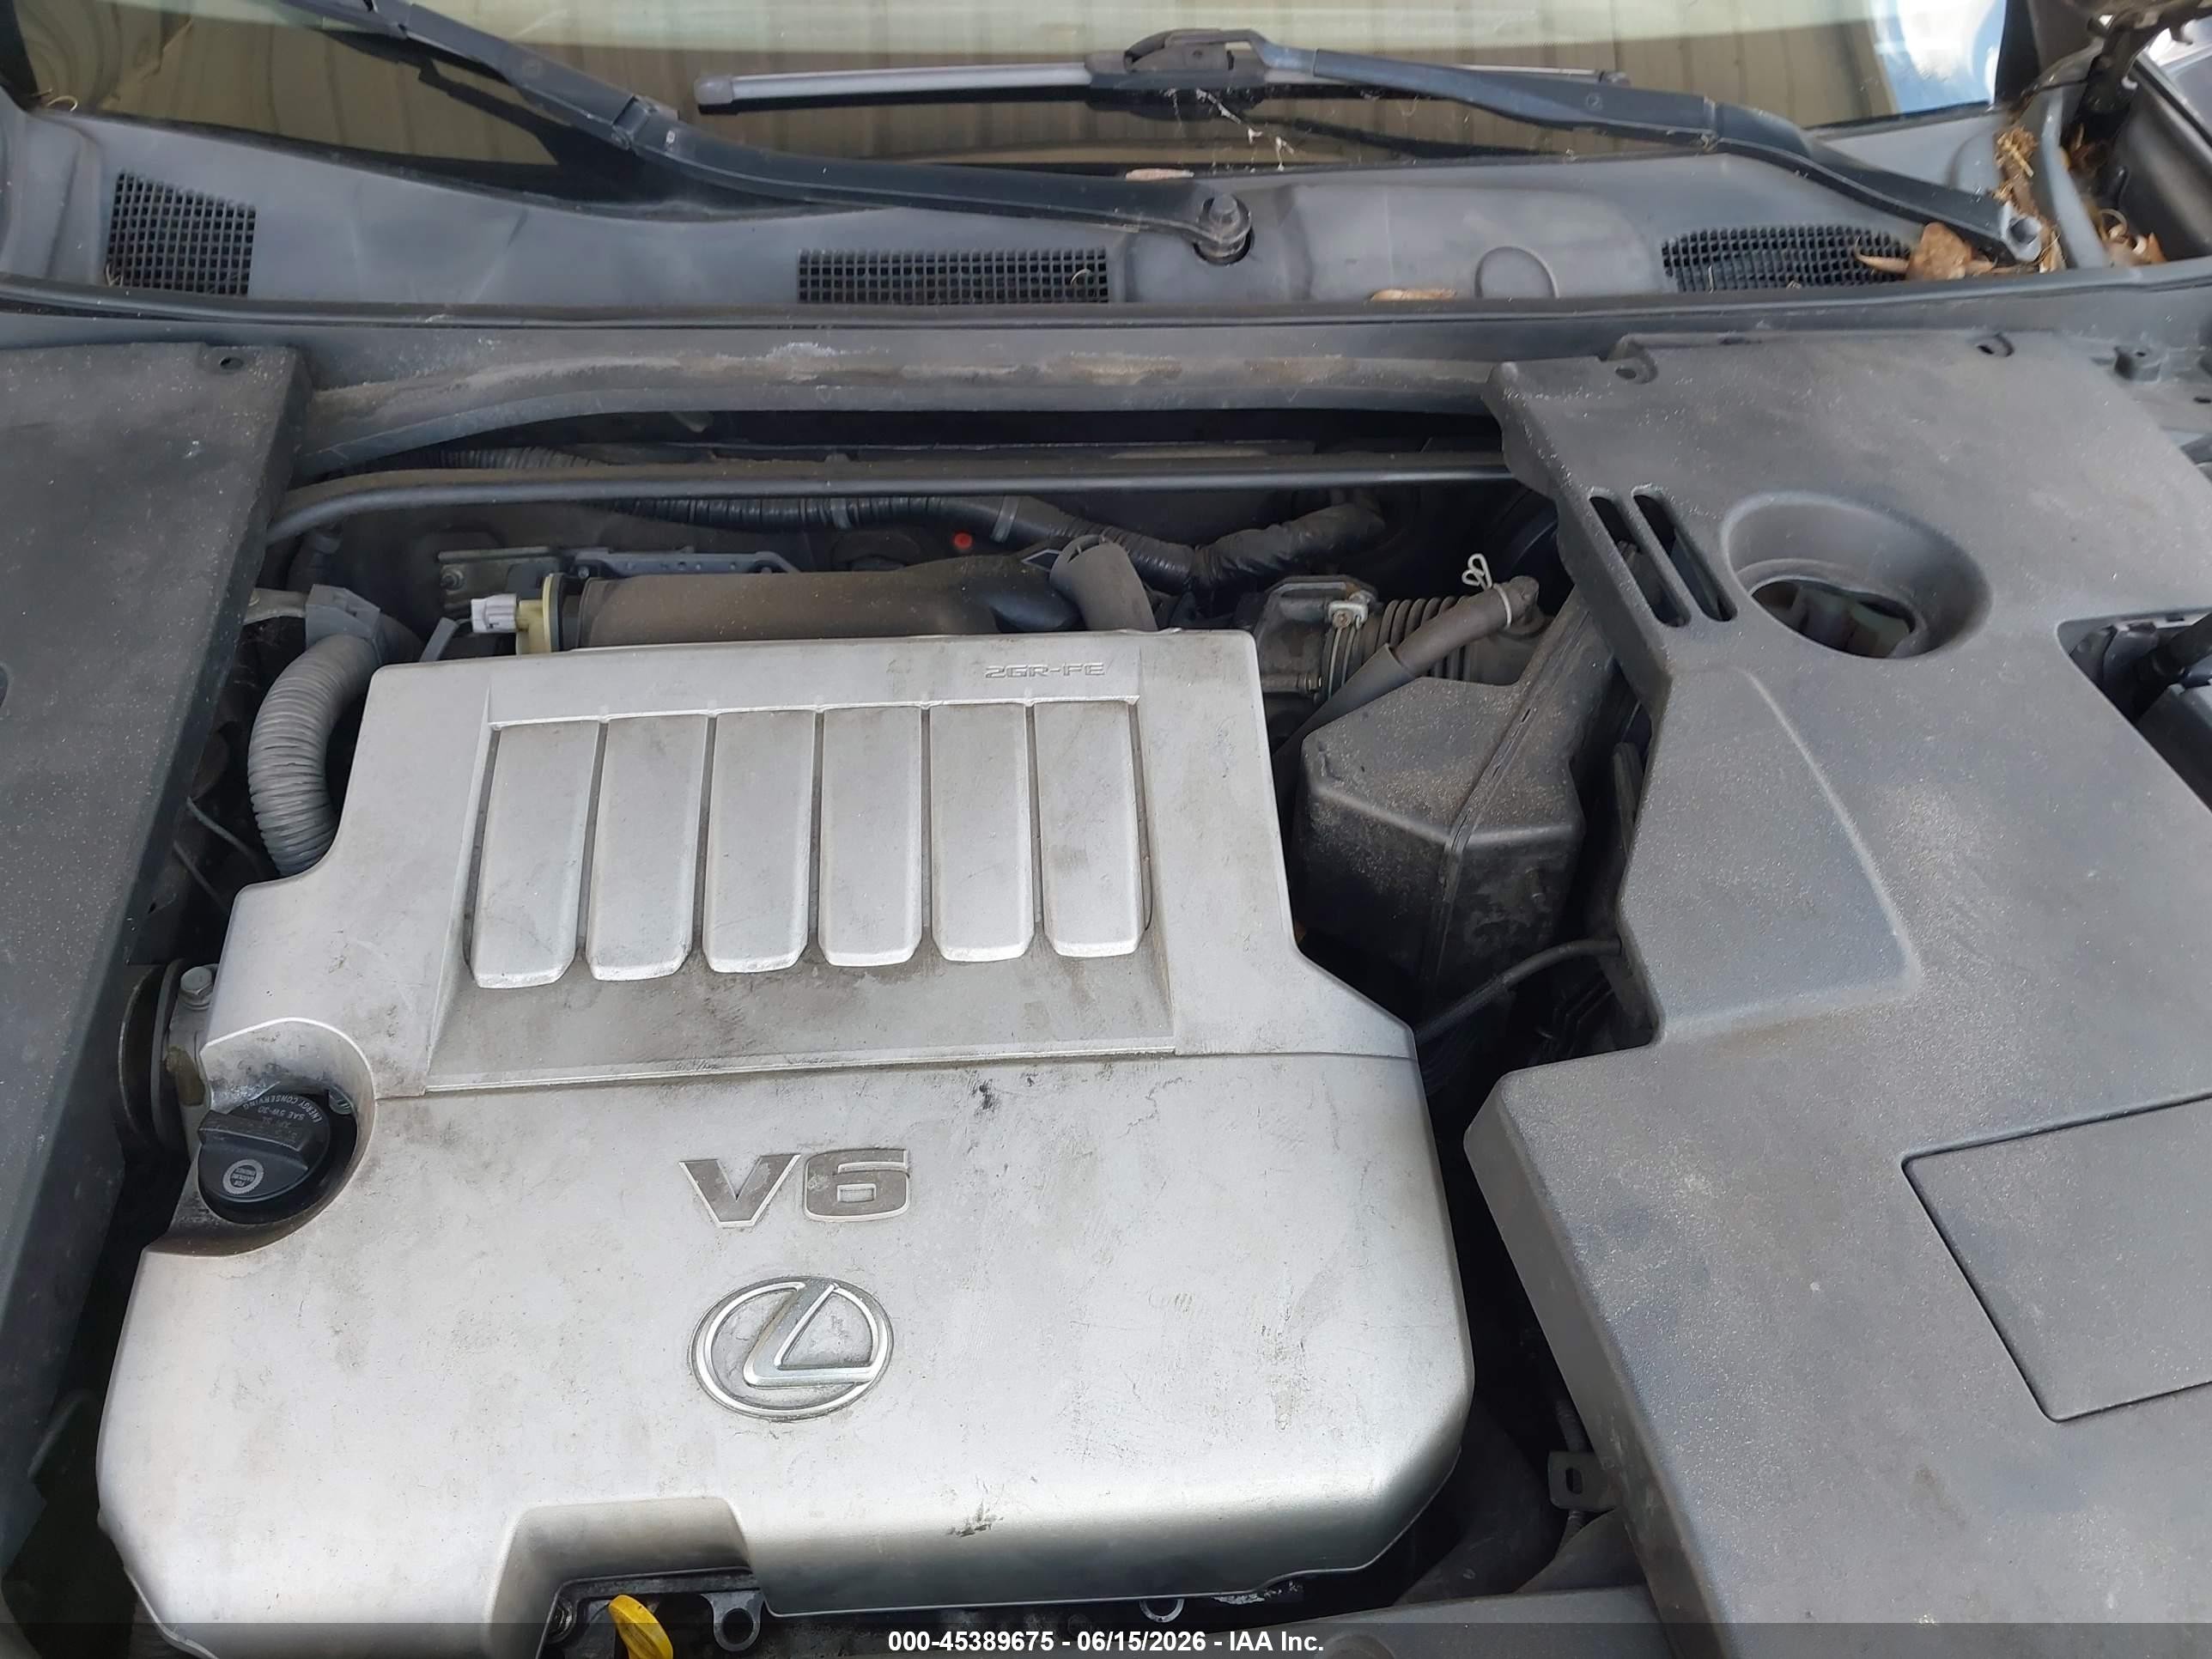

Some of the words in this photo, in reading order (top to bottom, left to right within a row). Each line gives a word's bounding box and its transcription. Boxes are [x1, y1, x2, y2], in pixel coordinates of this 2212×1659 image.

[986, 662, 1105, 678] 2GR-FE
[243, 1094, 298, 1110] CONSERVING
[258, 1106, 285, 1116] 5W-30
[287, 1110, 306, 1121] SAE
[299, 1099, 323, 1123] ENERGY
[678, 1148, 910, 1228] V6
